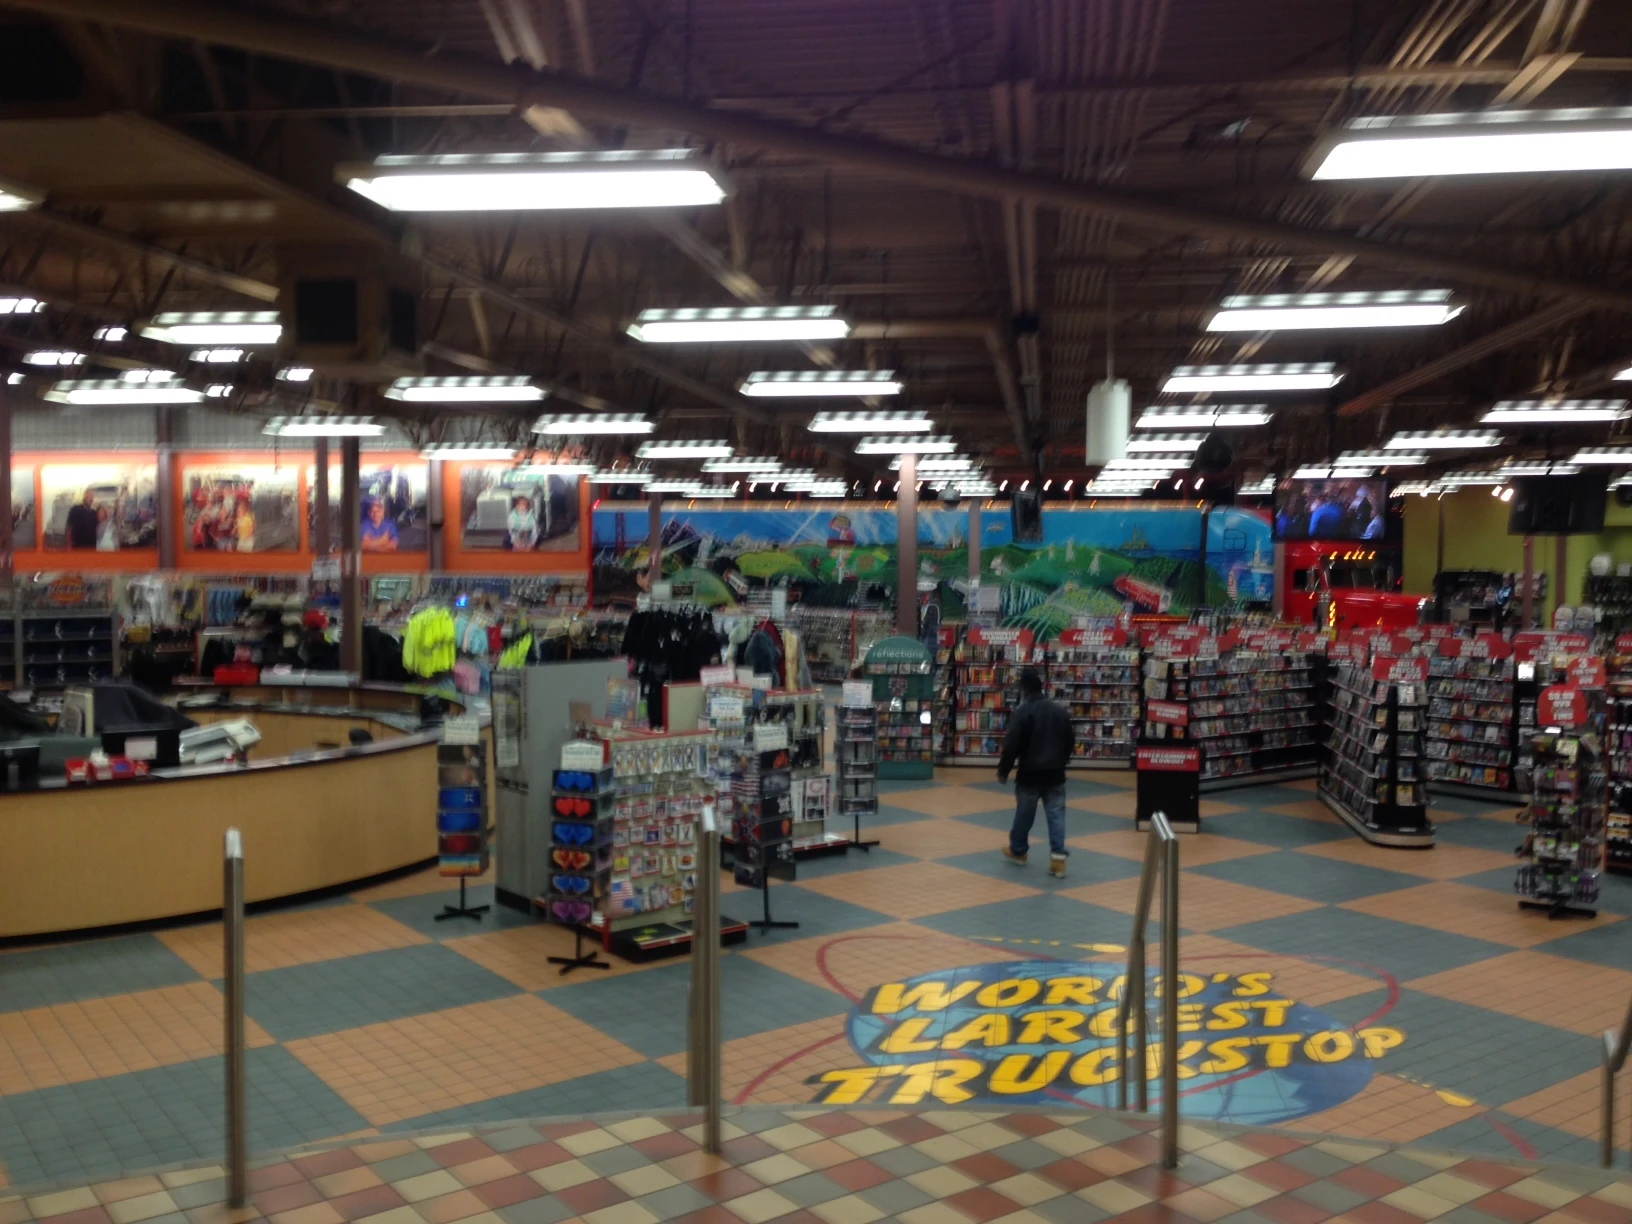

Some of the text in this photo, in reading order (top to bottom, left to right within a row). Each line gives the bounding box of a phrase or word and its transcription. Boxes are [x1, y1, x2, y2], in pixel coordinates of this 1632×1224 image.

[872, 650, 924, 660] reflections
[1138, 752, 1197, 760] ENTERTAINMENT
[818, 1026, 1406, 1105] TRUCKSTOP
